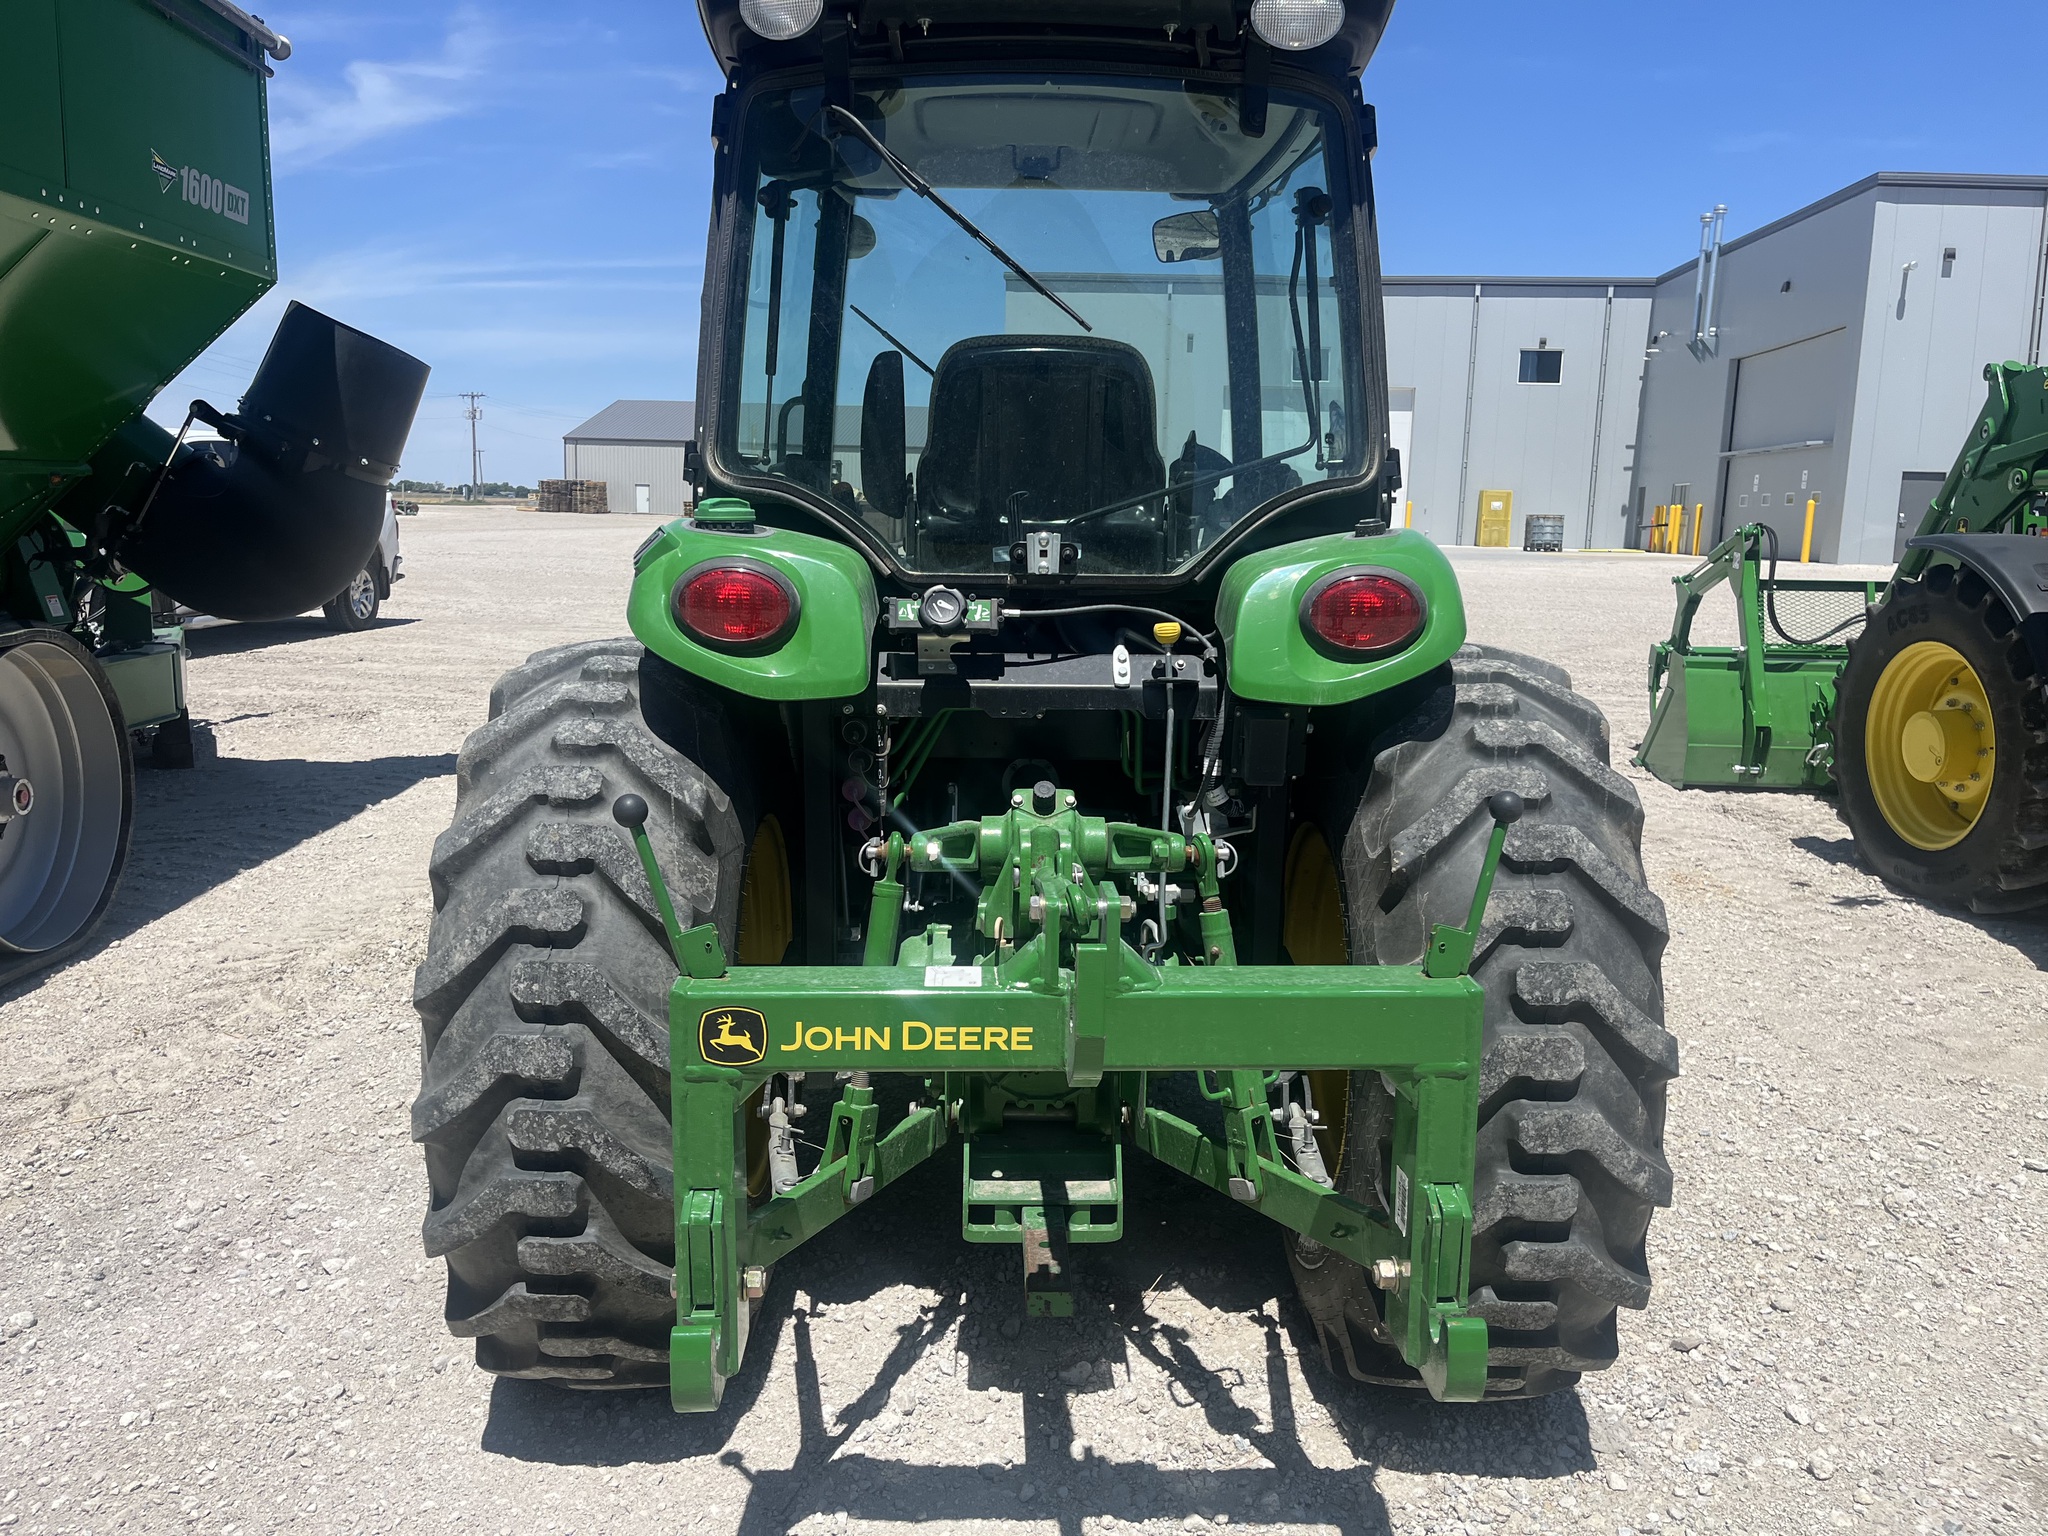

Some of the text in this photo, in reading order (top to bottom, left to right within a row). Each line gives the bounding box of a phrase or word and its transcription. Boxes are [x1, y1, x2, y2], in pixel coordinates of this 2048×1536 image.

[180, 165, 247, 218] 1600 DXT
[780, 1021, 1034, 1051] JOHN DEERE
